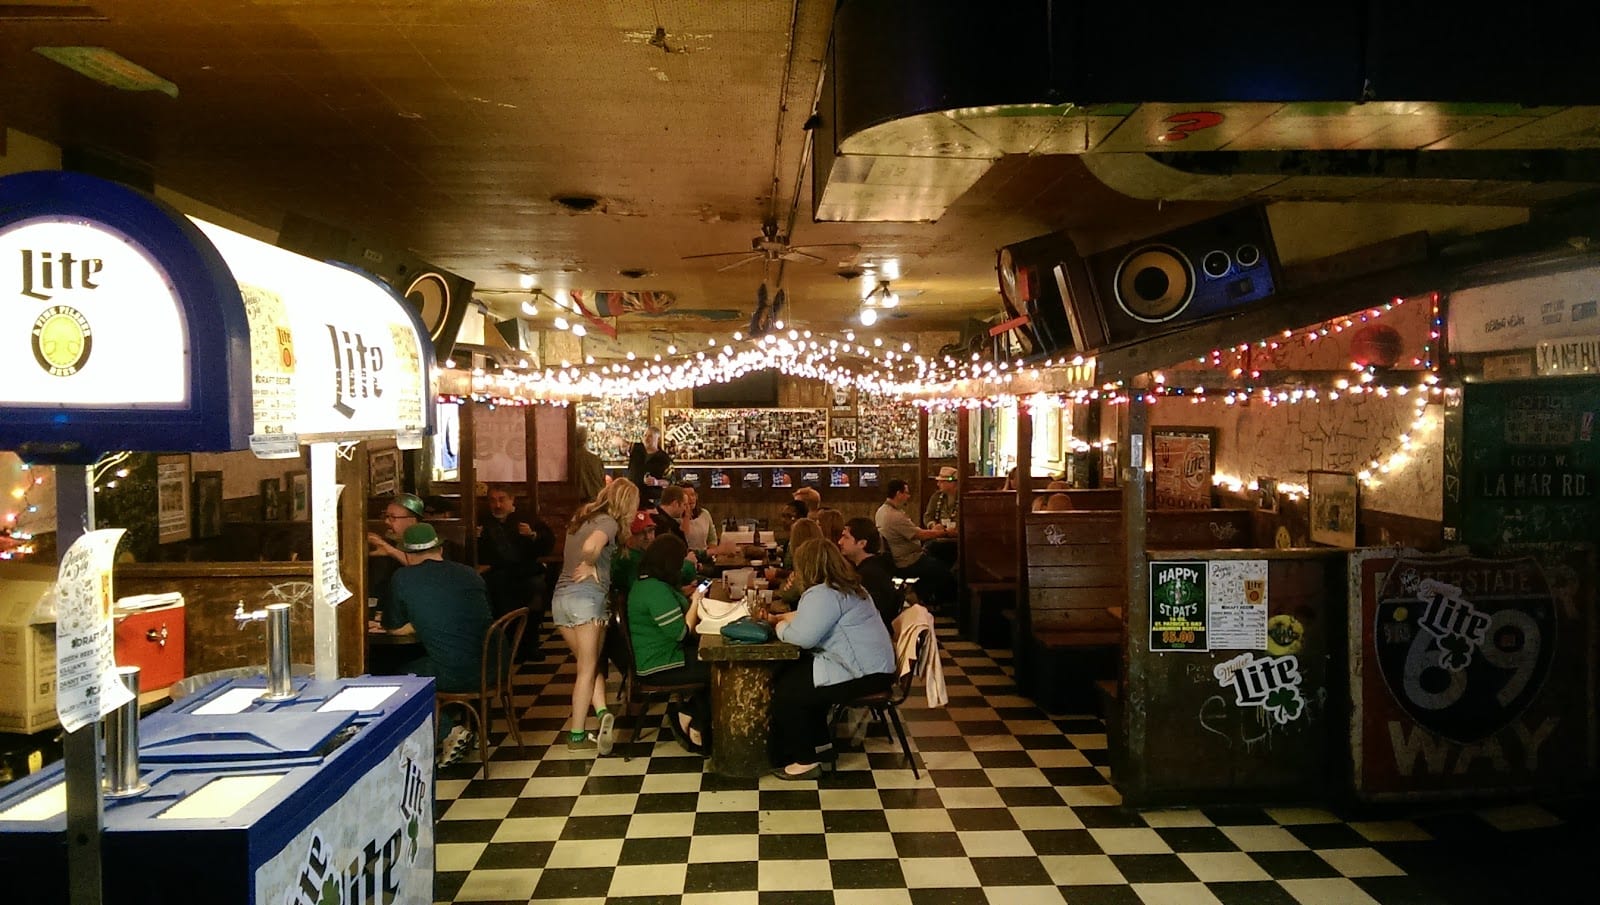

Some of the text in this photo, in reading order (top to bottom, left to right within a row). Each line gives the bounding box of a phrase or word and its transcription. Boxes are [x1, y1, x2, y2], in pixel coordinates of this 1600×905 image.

[20, 249, 104, 301] Lite
[277, 327, 292, 345] Lite
[324, 323, 384, 420] Lite
[1562, 473, 1593, 497] RD.
[1159, 567, 1199, 585] HAPPY
[1247, 580, 1263, 591] Lite
[1173, 602, 1198, 618] PAT'S
[1423, 594, 1488, 639] Lite
[1162, 631, 1196, 644] $5.00
[1404, 608, 1542, 711] 69
[1235, 660, 1295, 703] Lite
[401, 757, 426, 820] Lite
[342, 828, 402, 905] ite
